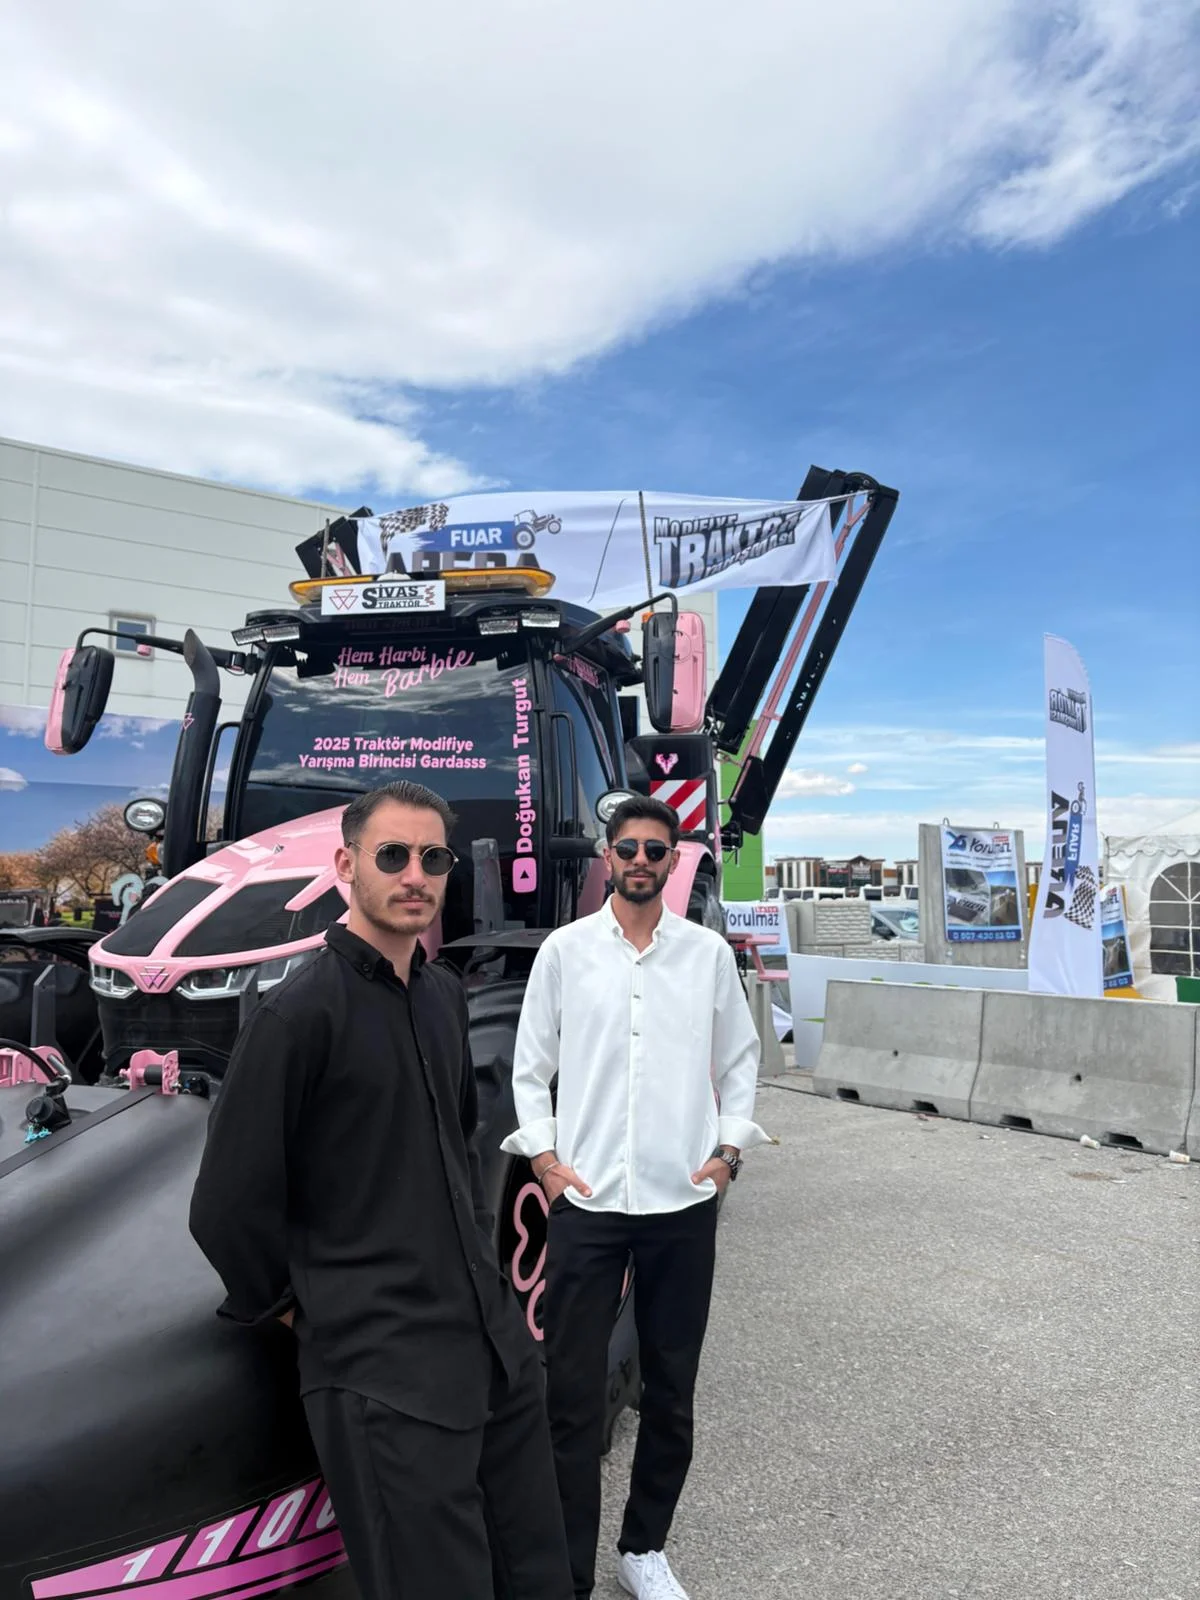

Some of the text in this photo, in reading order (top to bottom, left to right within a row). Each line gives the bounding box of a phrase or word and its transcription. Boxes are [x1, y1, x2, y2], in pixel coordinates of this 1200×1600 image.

[450, 528, 503, 548] FUAR
[338, 646, 427, 666] Hem Harbi
[333, 647, 475, 698] Hem Barbie
[512, 678, 532, 749] Turgut
[313, 736, 474, 755] 2025 Traktör Modifiye
[298, 753, 487, 772] Yarışma Birincisi Gardasss
[515, 754, 537, 853] Doğukan
